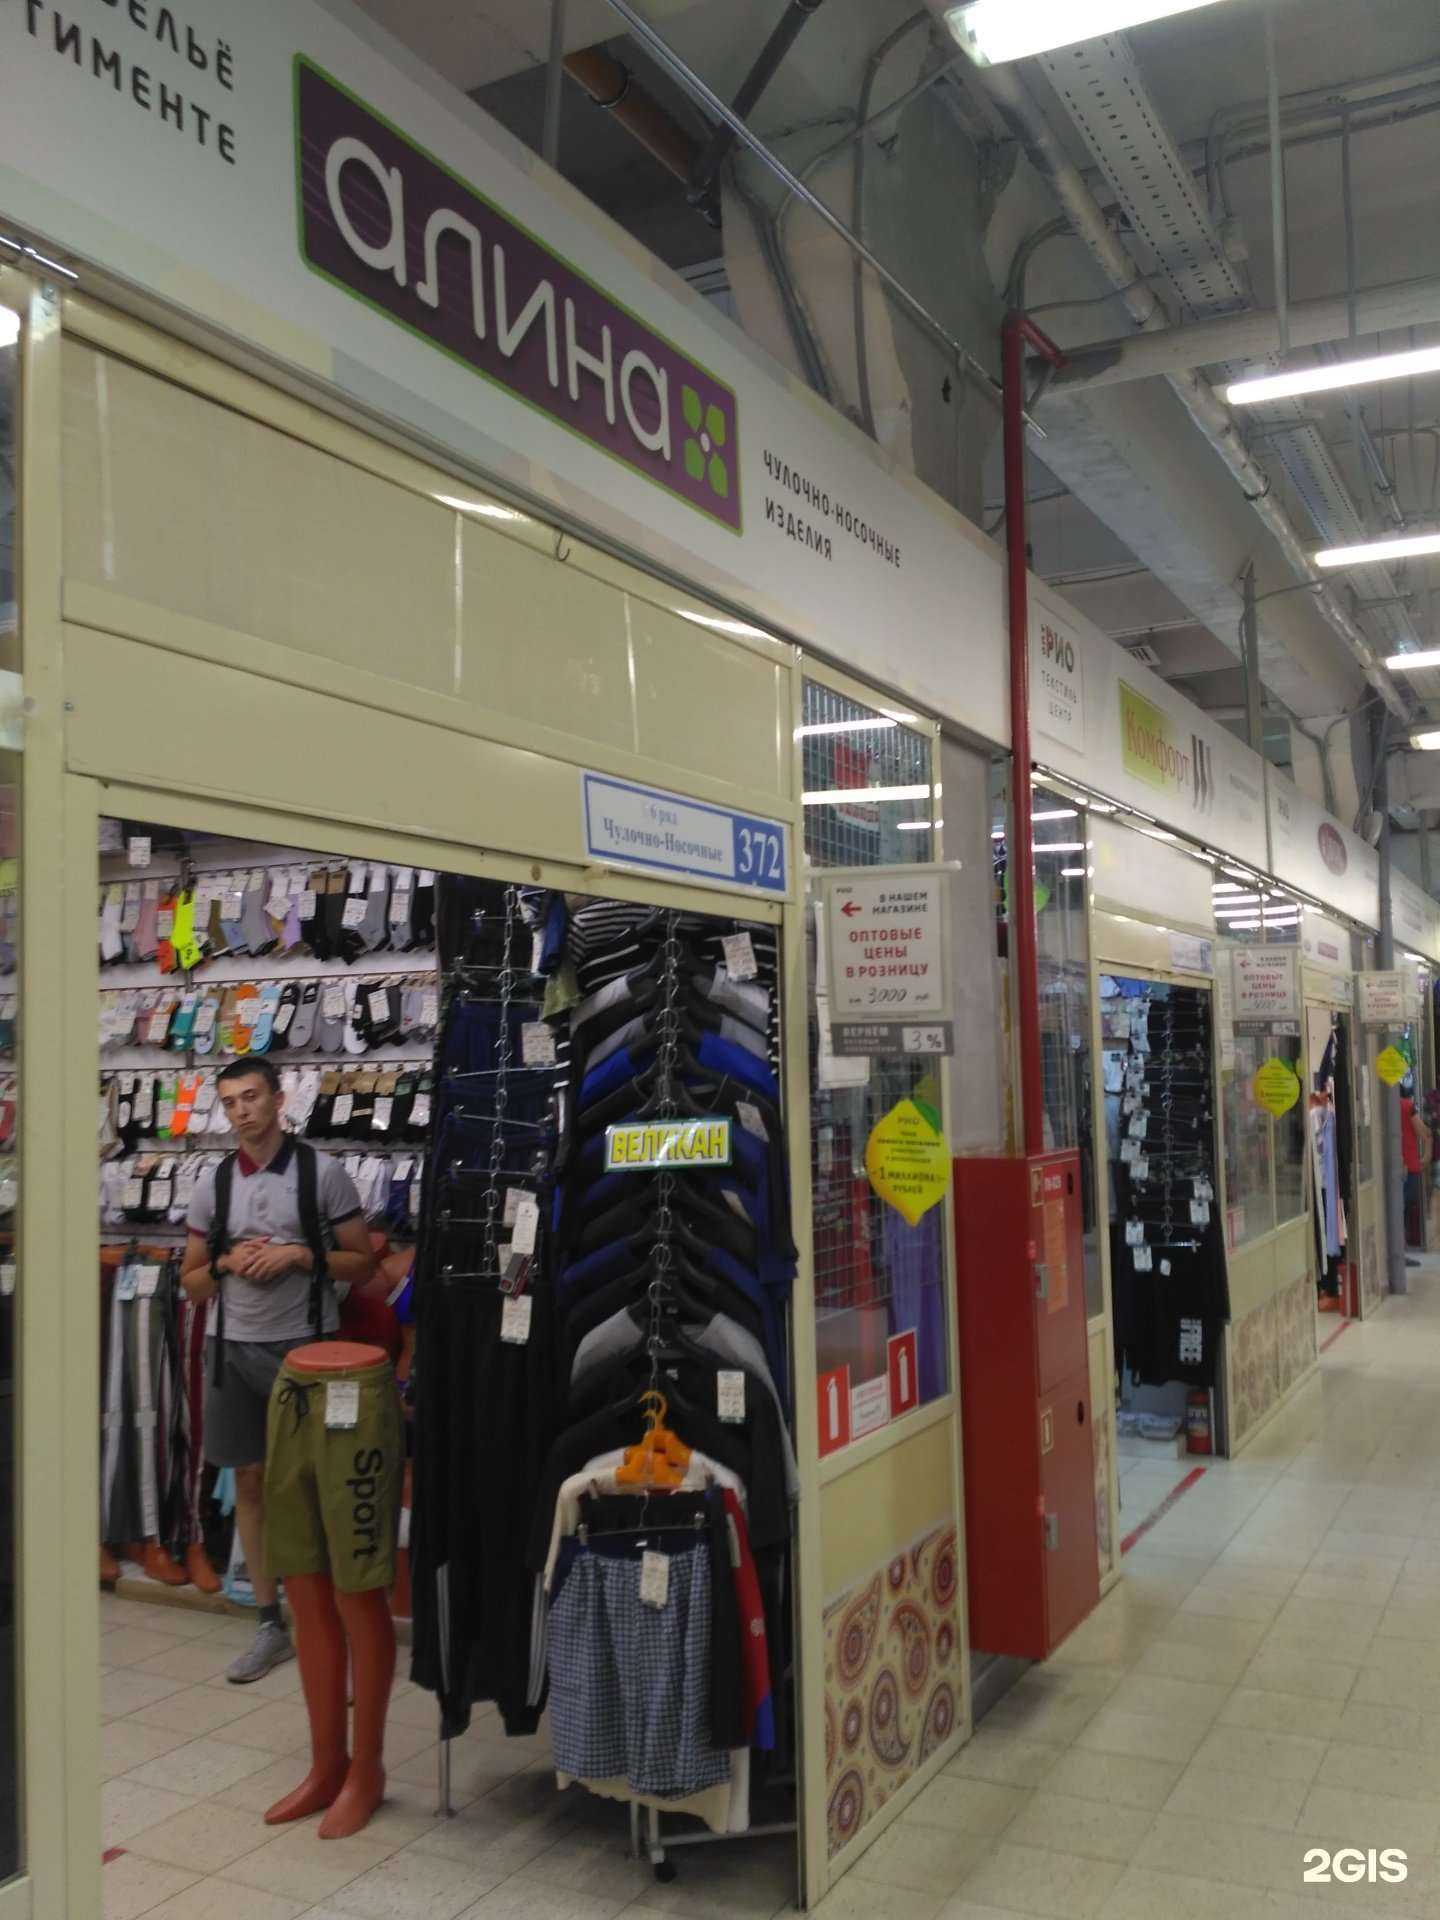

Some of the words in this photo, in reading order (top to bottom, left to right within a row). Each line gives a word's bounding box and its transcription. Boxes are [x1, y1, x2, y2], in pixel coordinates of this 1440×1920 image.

[102, 0, 234, 91] ЕЛЬЁ
[763, 449, 901, 568] ЧУЛОЧНО-НОСОЧНЫЕ
[765, 496, 832, 561] ИЗДЕЛИЯ
[603, 817, 724, 864] Чулочно-Носочные
[739, 828, 782, 879] 372
[872, 903, 929, 914] МАГАЗИНЕ
[888, 892, 928, 902] НАШЕМ
[848, 927, 923, 943] ОПТОВЫЕ
[864, 945, 908, 960] ЦЕНЫ
[846, 966, 854, 978] В
[858, 963, 929, 977] РОЗНИЦУ
[611, 1125, 726, 1163] ВЕЛИКАН
[345, 1447, 384, 1561] Sport
